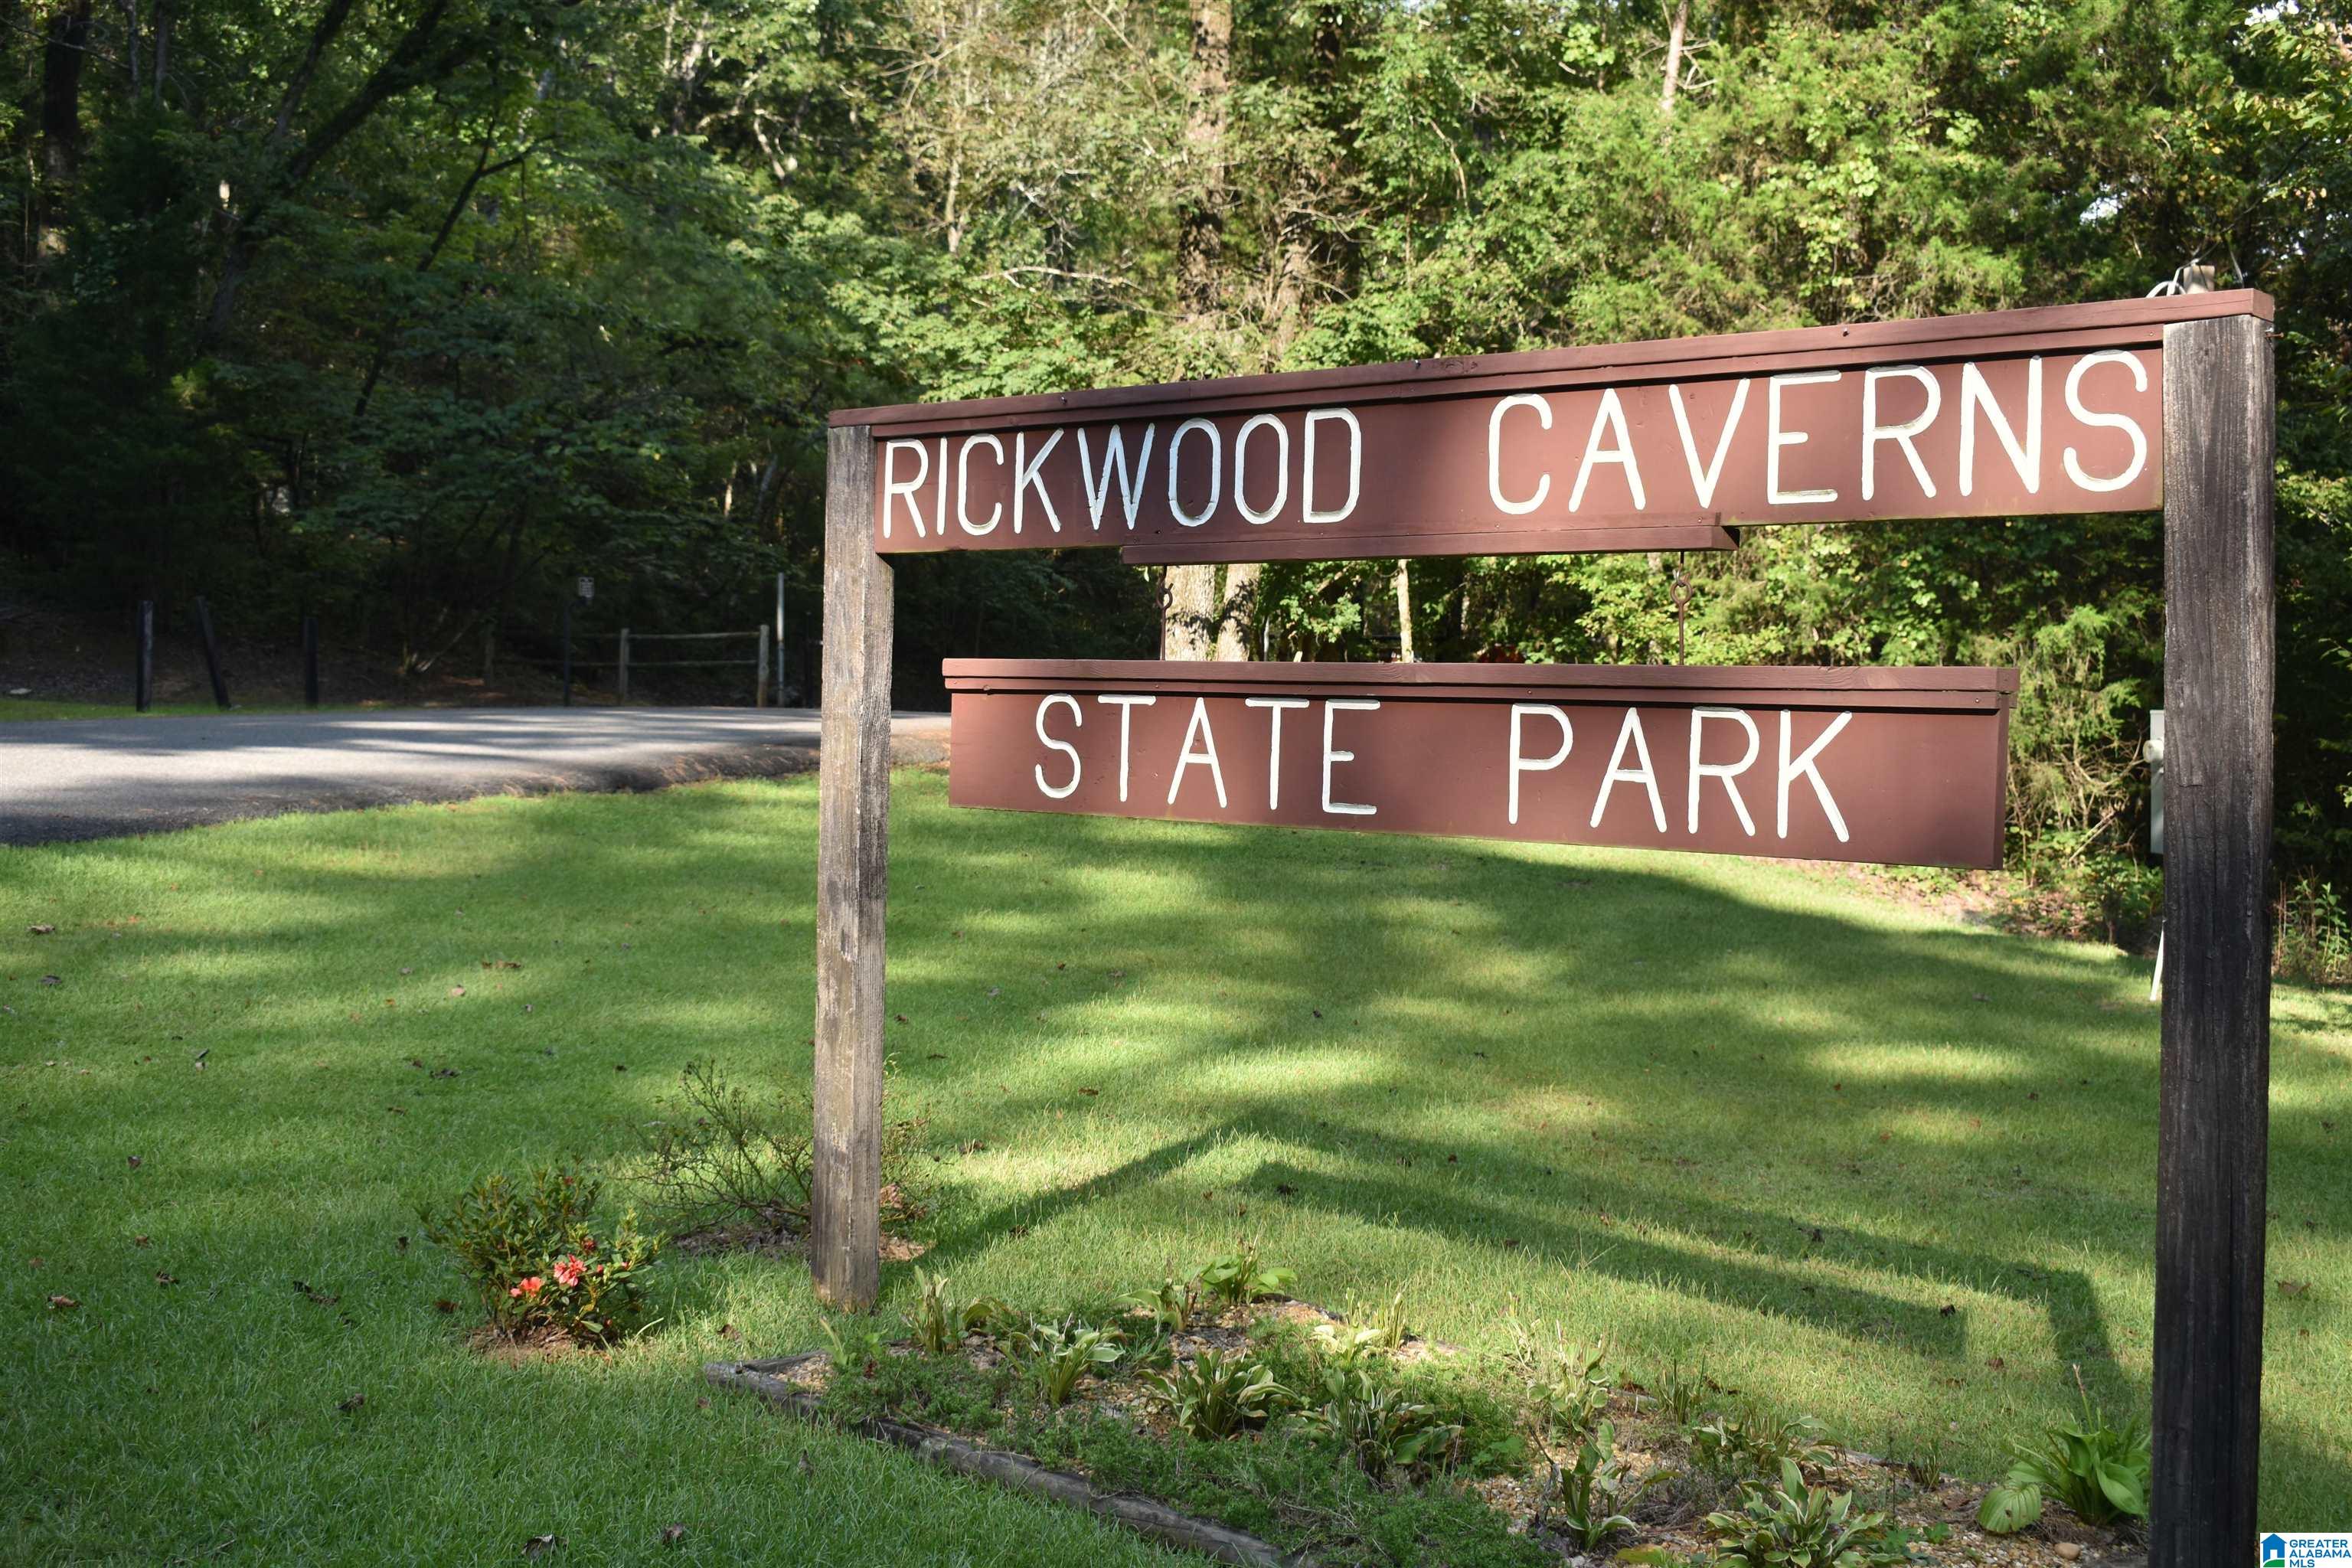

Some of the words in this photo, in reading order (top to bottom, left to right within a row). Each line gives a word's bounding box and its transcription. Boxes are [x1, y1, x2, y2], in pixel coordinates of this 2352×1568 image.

[883, 407, 1361, 538] RICKWOOD
[1488, 350, 2148, 515] CAVERNS
[1035, 693, 1380, 815] STATE
[1508, 703, 1852, 842] PARK
